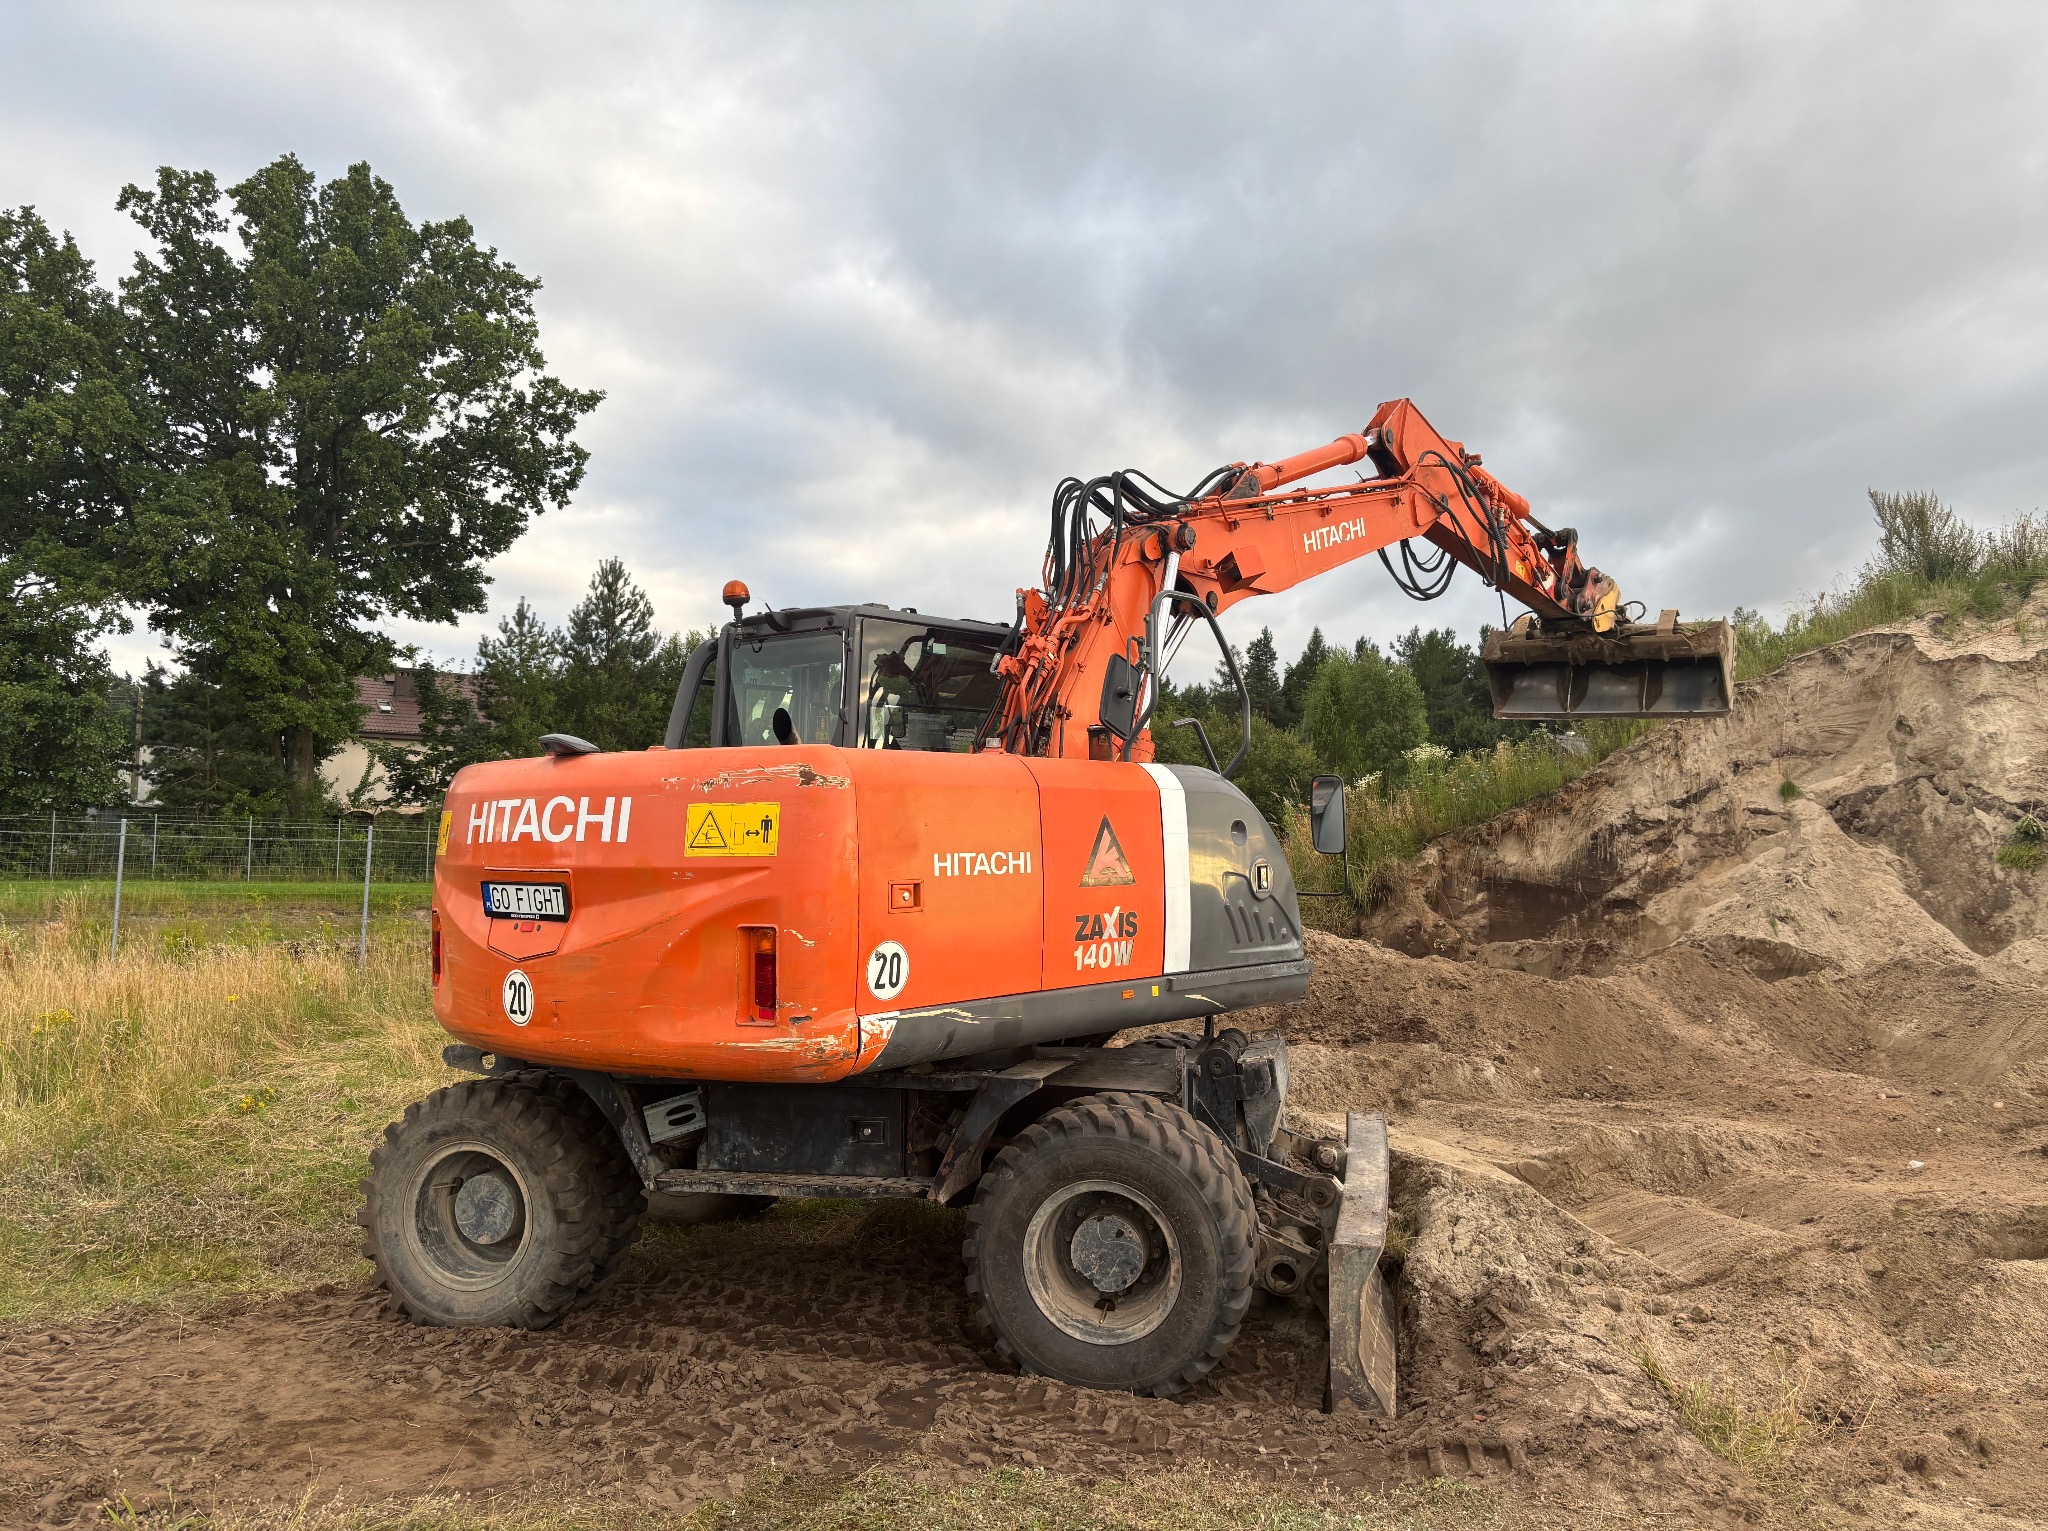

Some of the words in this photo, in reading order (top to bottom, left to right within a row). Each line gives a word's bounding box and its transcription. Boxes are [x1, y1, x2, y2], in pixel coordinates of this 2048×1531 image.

[1303, 517, 1366, 553] HITACHI
[466, 796, 632, 844] HITACHI
[933, 851, 1032, 877] HITACHI
[491, 886, 511, 910] GO
[515, 887, 561, 913] FIGHT
[1074, 905, 1138, 942] ZAXIS
[873, 952, 903, 990] 20
[1073, 939, 1135, 971] 140W
[508, 979, 527, 1018] 20
